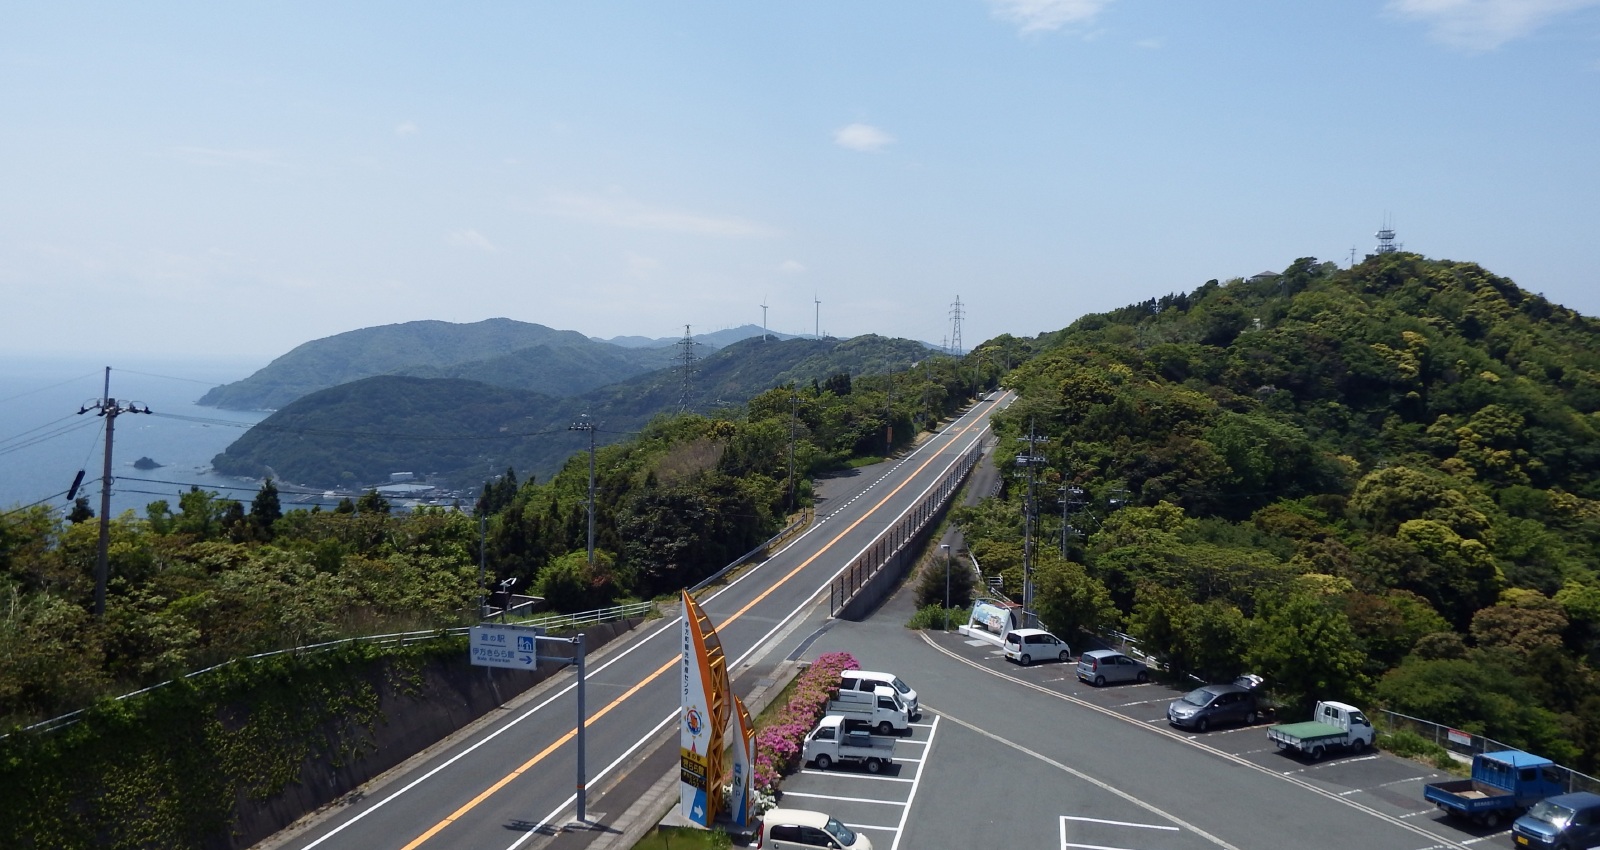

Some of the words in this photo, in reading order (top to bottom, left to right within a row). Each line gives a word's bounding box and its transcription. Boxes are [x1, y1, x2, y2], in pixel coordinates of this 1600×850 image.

[481, 633, 506, 643] 道の駅
[472, 647, 515, 659] 伊方きらら館
